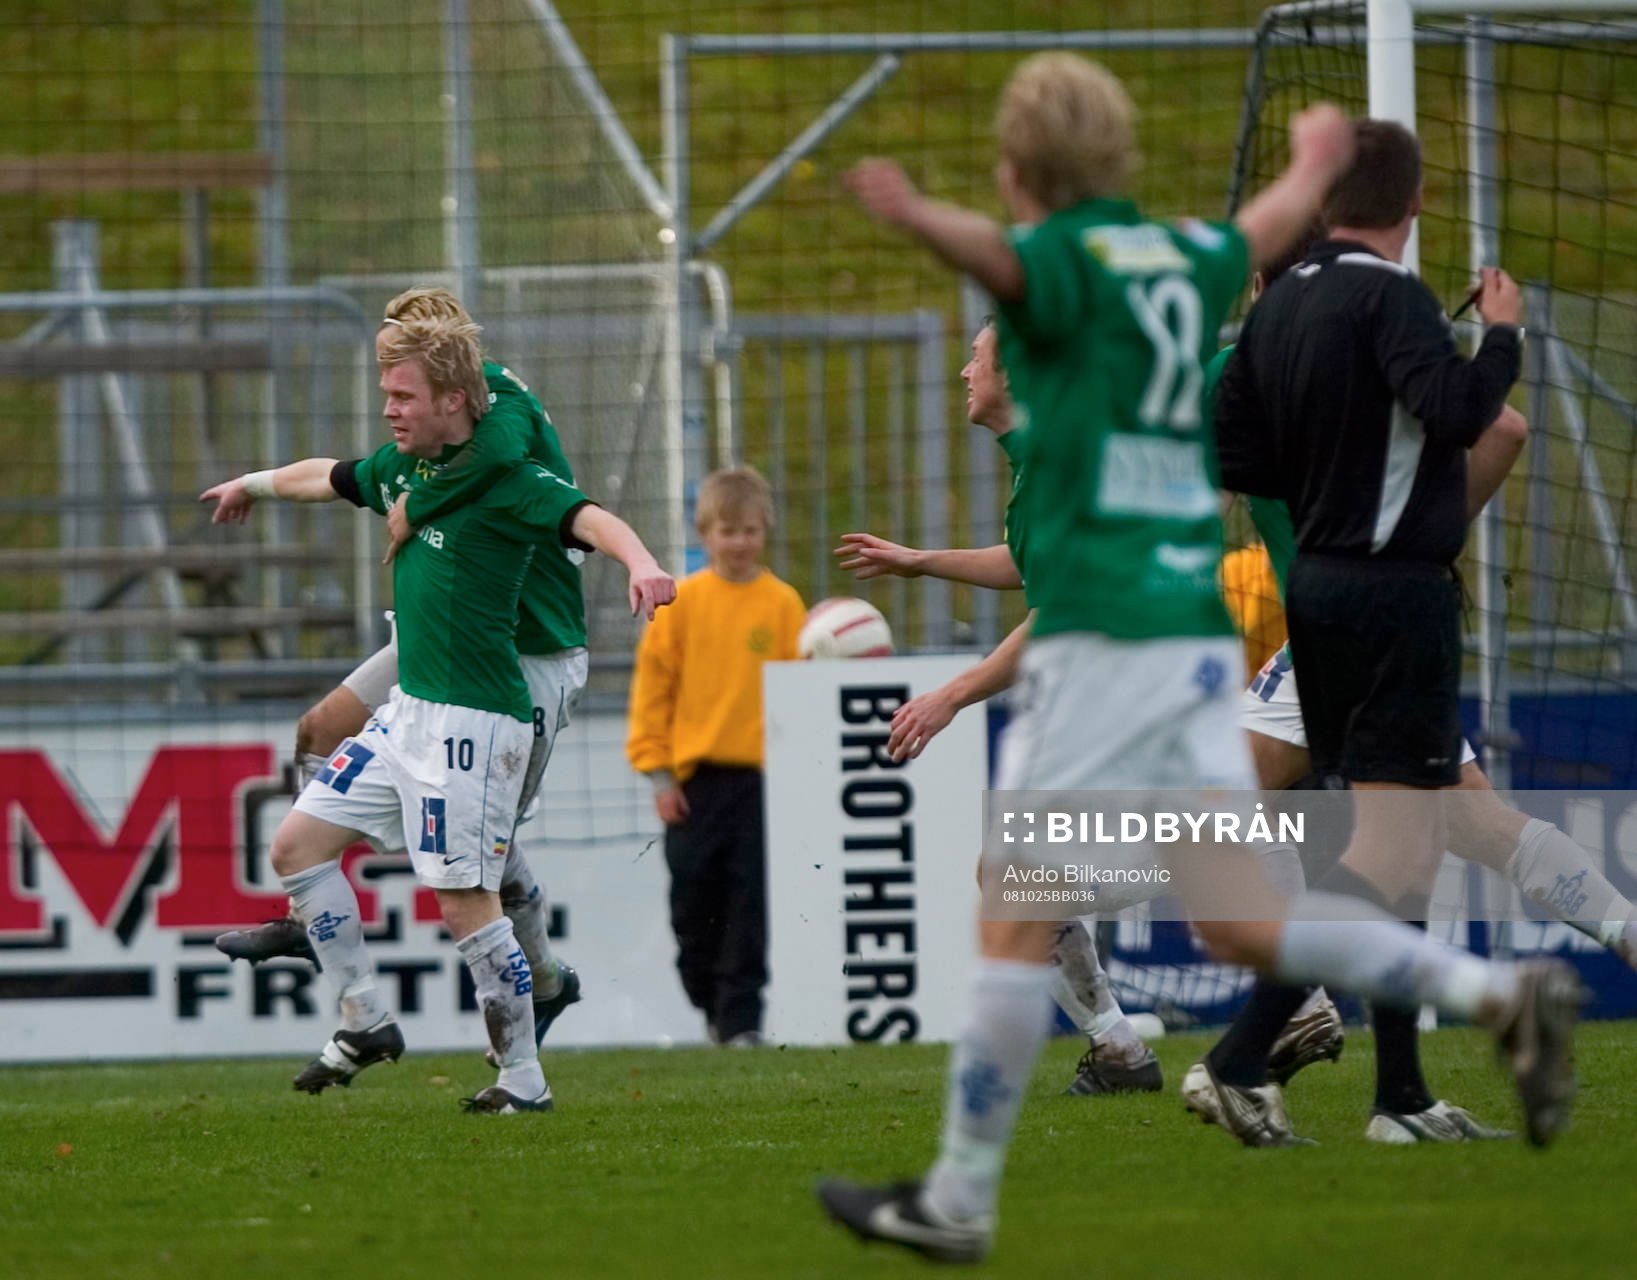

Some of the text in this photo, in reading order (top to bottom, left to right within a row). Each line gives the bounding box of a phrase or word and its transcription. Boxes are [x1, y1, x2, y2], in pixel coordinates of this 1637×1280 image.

[443, 737, 475, 772] 10
[839, 683, 921, 1043] BROTHERS
[507, 946, 533, 997] TSAB
